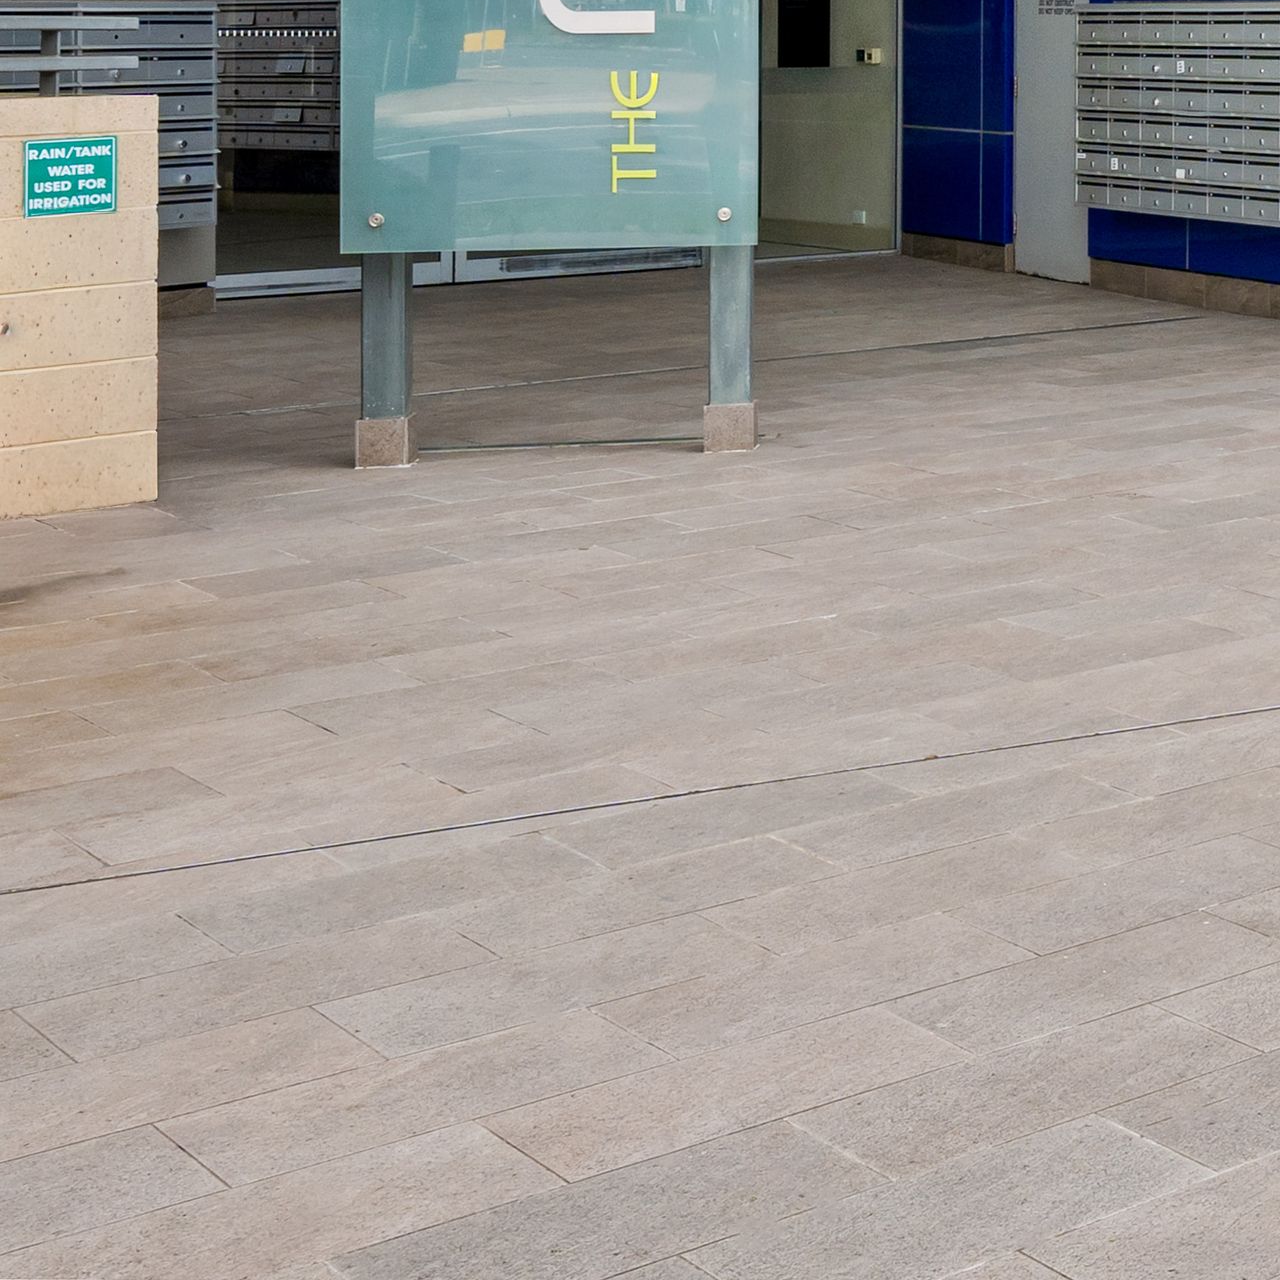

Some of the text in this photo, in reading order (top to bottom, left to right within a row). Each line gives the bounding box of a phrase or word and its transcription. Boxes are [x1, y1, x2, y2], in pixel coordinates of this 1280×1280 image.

[610, 69, 660, 194] THE
[28, 145, 112, 160] RAIN/TANK
[47, 164, 95, 177] WATER
[33, 178, 107, 193] USED FOR
[28, 193, 112, 210] IRRIGATION
